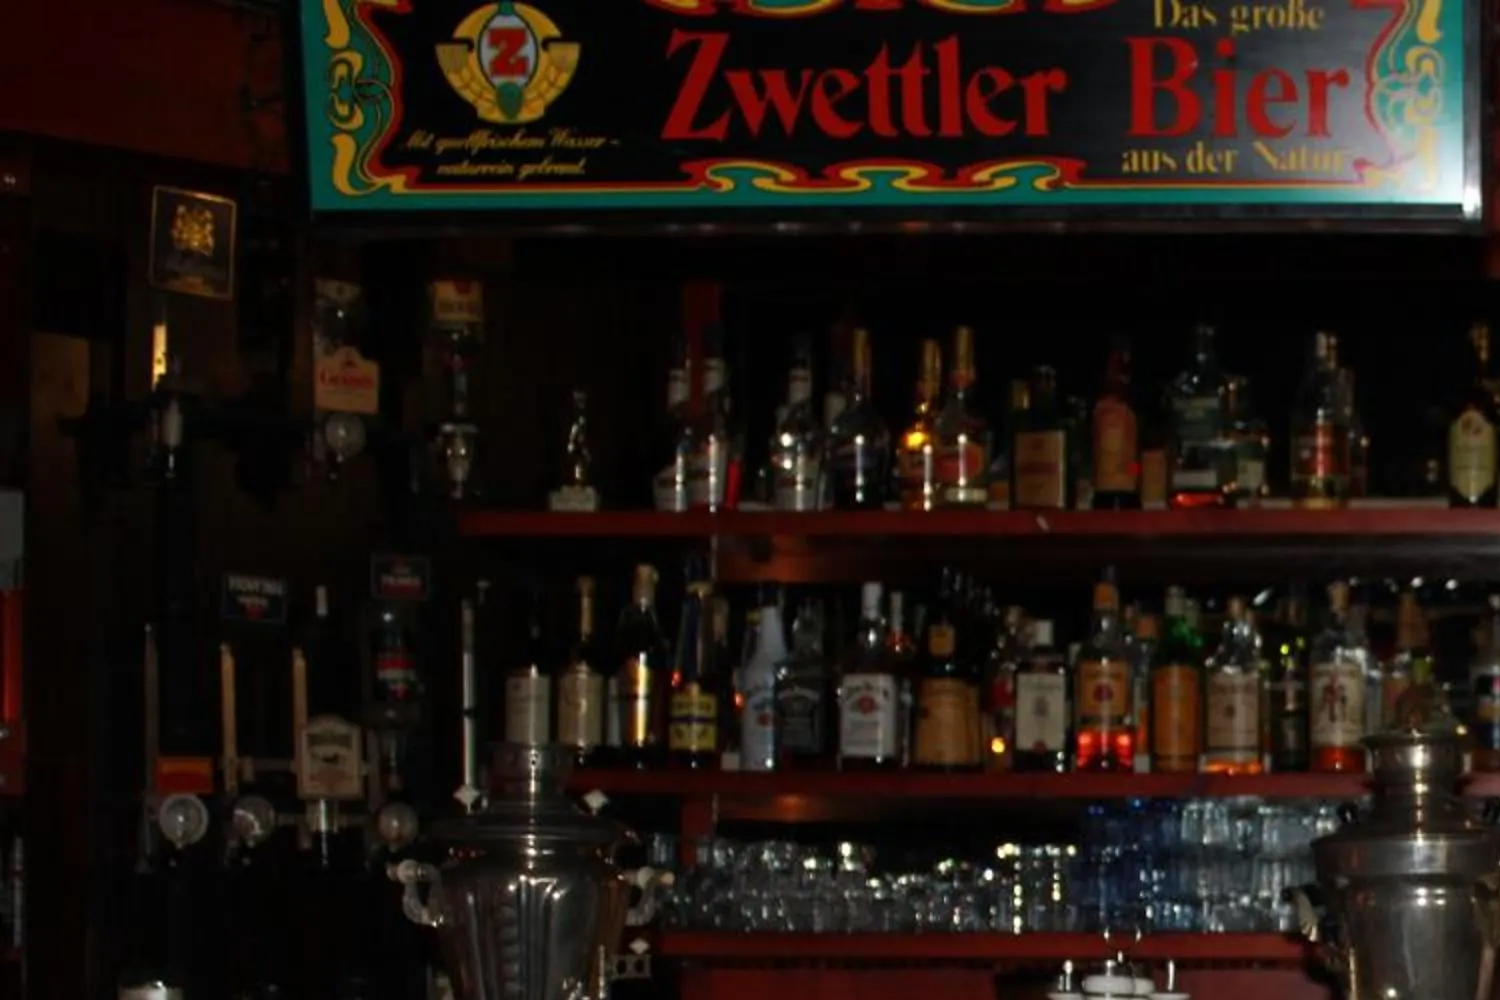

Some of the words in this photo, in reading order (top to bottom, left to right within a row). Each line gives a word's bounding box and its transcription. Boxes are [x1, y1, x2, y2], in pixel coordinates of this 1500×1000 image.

[1153, 0, 1217, 28] Das
[488, 28, 529, 76] Z
[662, 28, 1068, 142] Zwettler
[1121, 35, 1350, 139] Bier
[1121, 148, 1177, 173] aus
[1186, 141, 1239, 173] der
